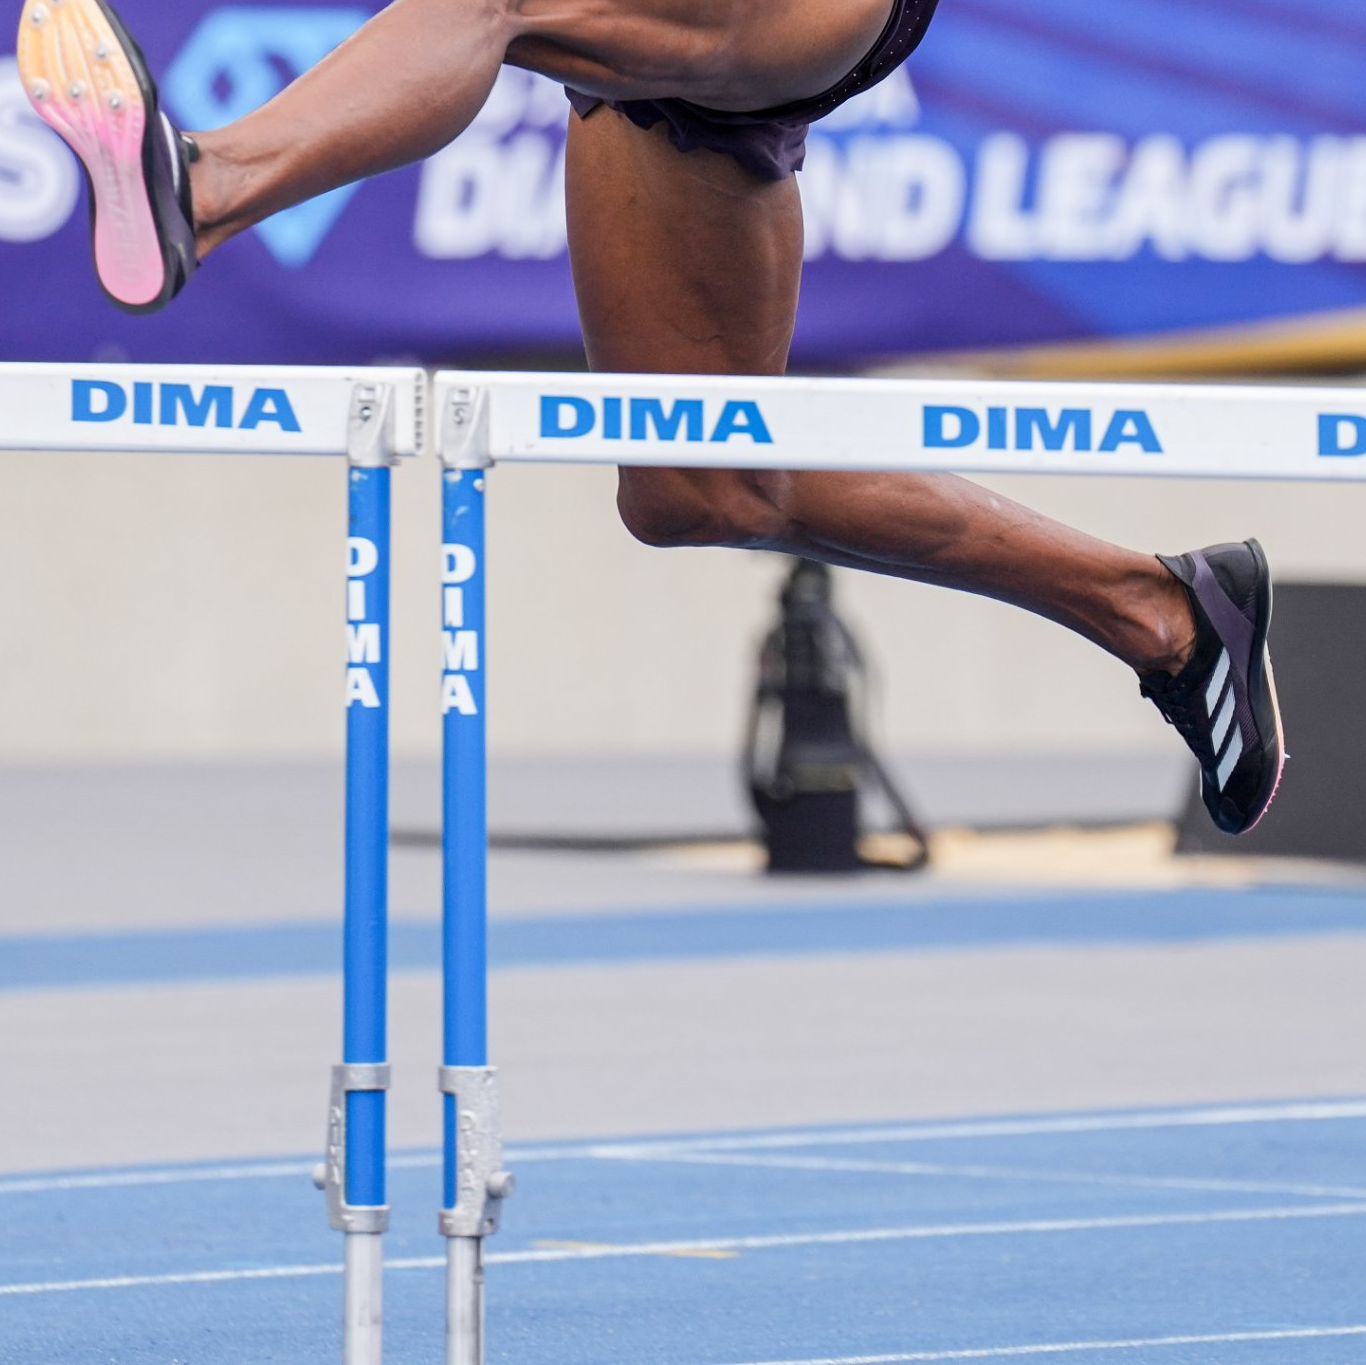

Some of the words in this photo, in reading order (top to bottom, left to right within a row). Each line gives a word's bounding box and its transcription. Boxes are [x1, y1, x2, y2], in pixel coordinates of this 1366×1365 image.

[70, 379, 302, 433] DIMA
[539, 394, 774, 445] DIMA
[922, 404, 1164, 454] DIMA
[346, 537, 381, 708] DIMA
[441, 543, 479, 715] DIMA
